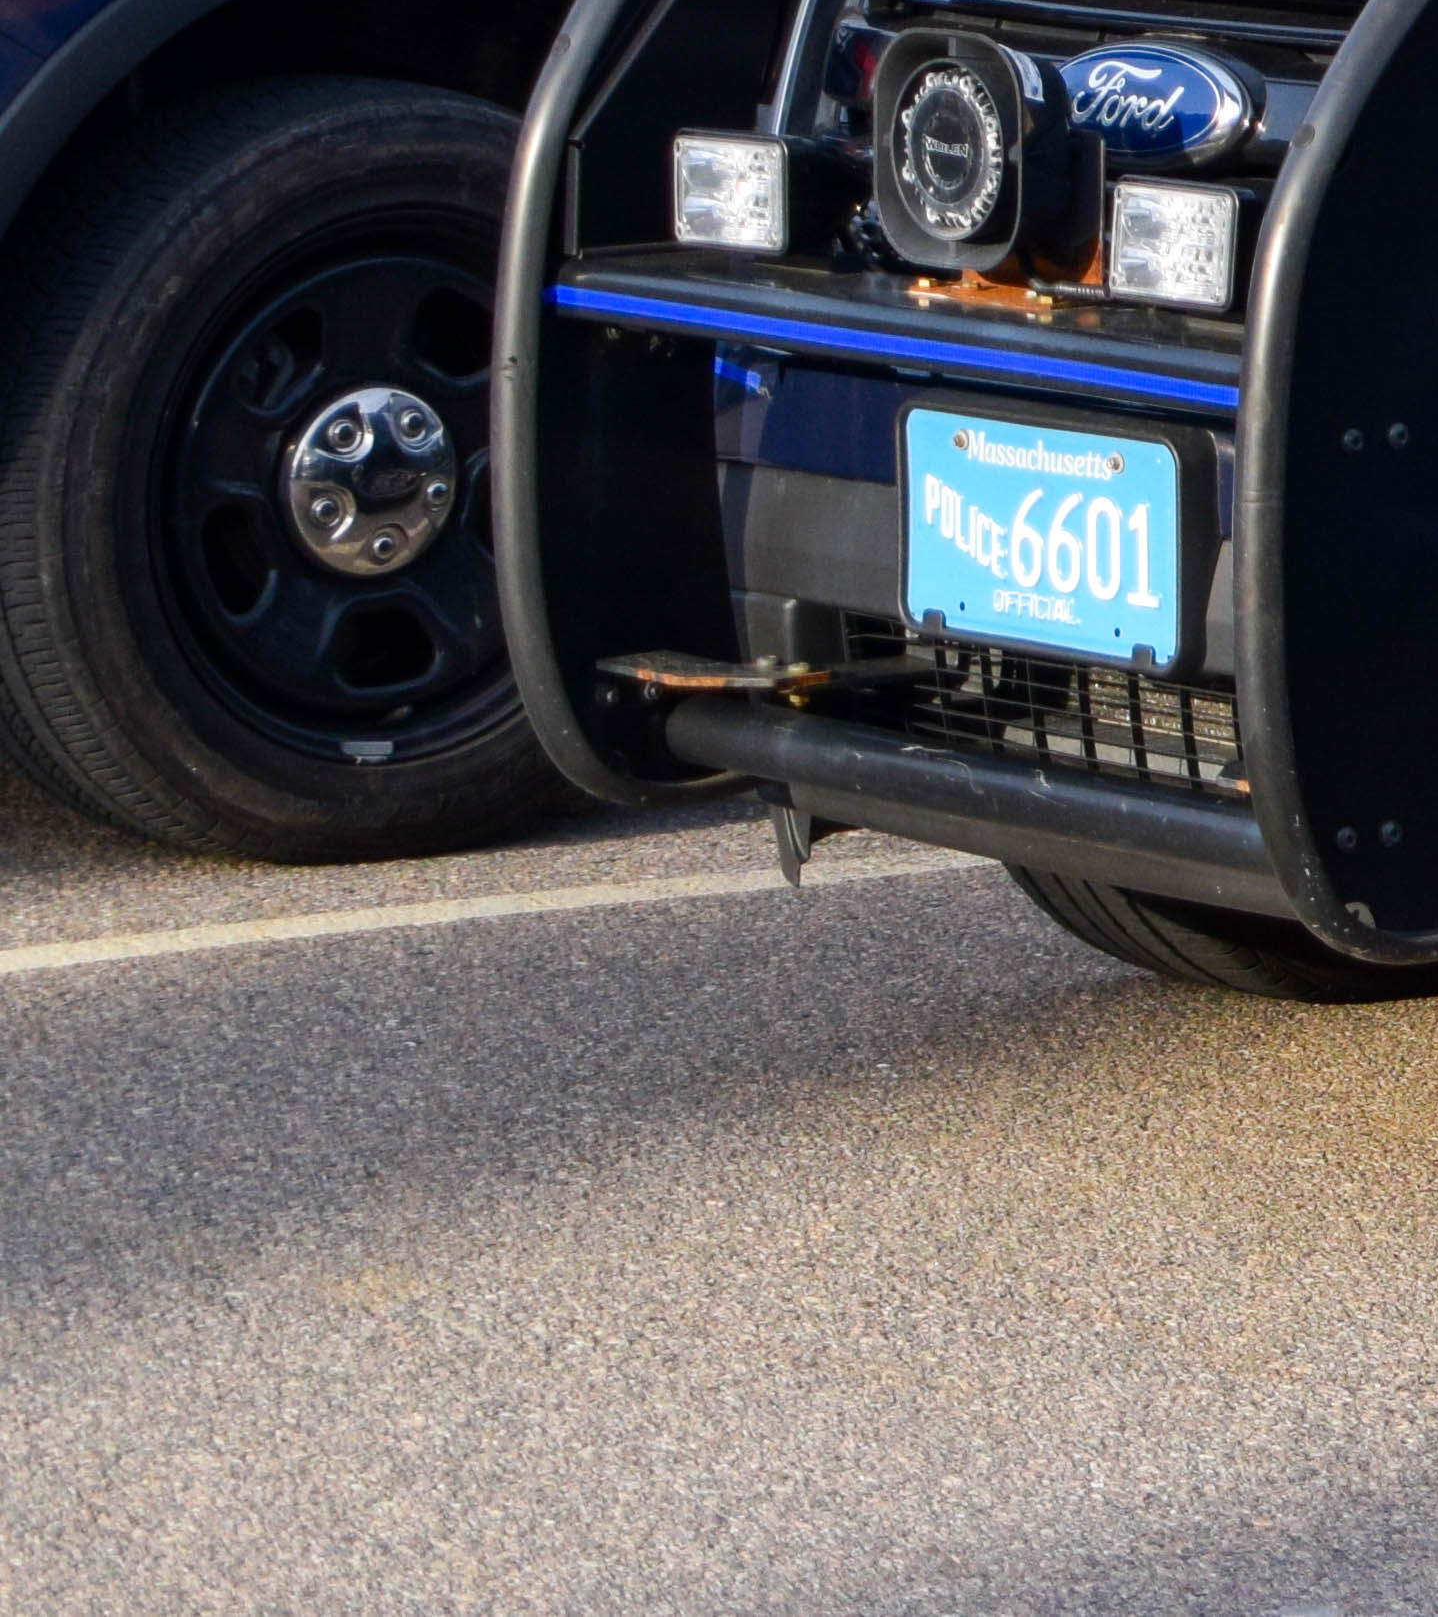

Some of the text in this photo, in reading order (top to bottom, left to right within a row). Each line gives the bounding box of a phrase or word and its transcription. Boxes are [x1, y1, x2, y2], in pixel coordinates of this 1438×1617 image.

[1071, 60, 1185, 130] Ford
[966, 429, 1113, 481] Massachusetts
[925, 473, 1162, 610] POLICE 6601
[993, 589, 1082, 625] OFFICIAL
